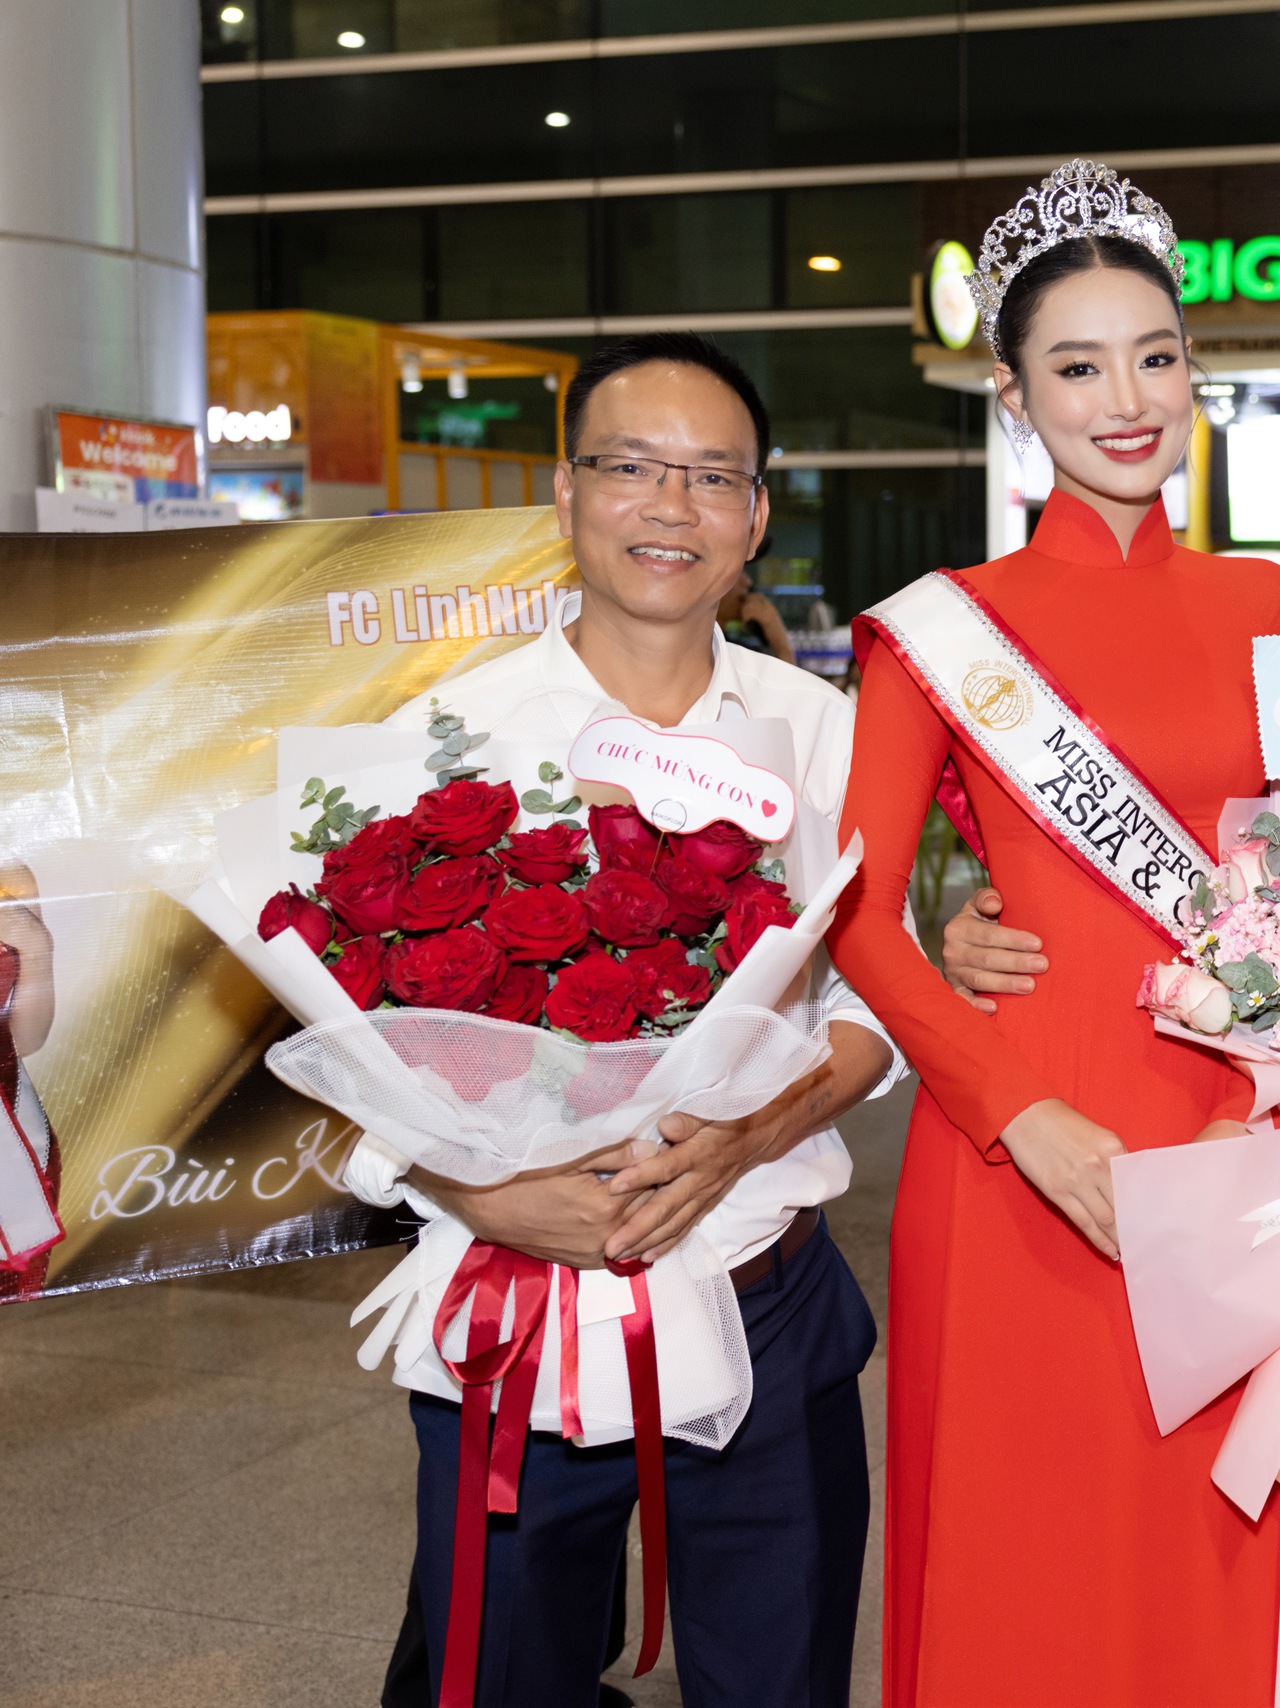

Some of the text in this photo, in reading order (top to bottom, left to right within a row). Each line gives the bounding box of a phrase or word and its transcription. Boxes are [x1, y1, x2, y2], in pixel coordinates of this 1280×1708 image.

[79, 440, 177, 472] Welcome
[325, 589, 382, 647] FC
[596, 740, 650, 765] CHÚC
[716, 780, 756, 809] CON
[1042, 724, 1118, 800] MISS
[1034, 769, 1162, 900] ASIA &
[89, 1144, 237, 1221] Bùi
